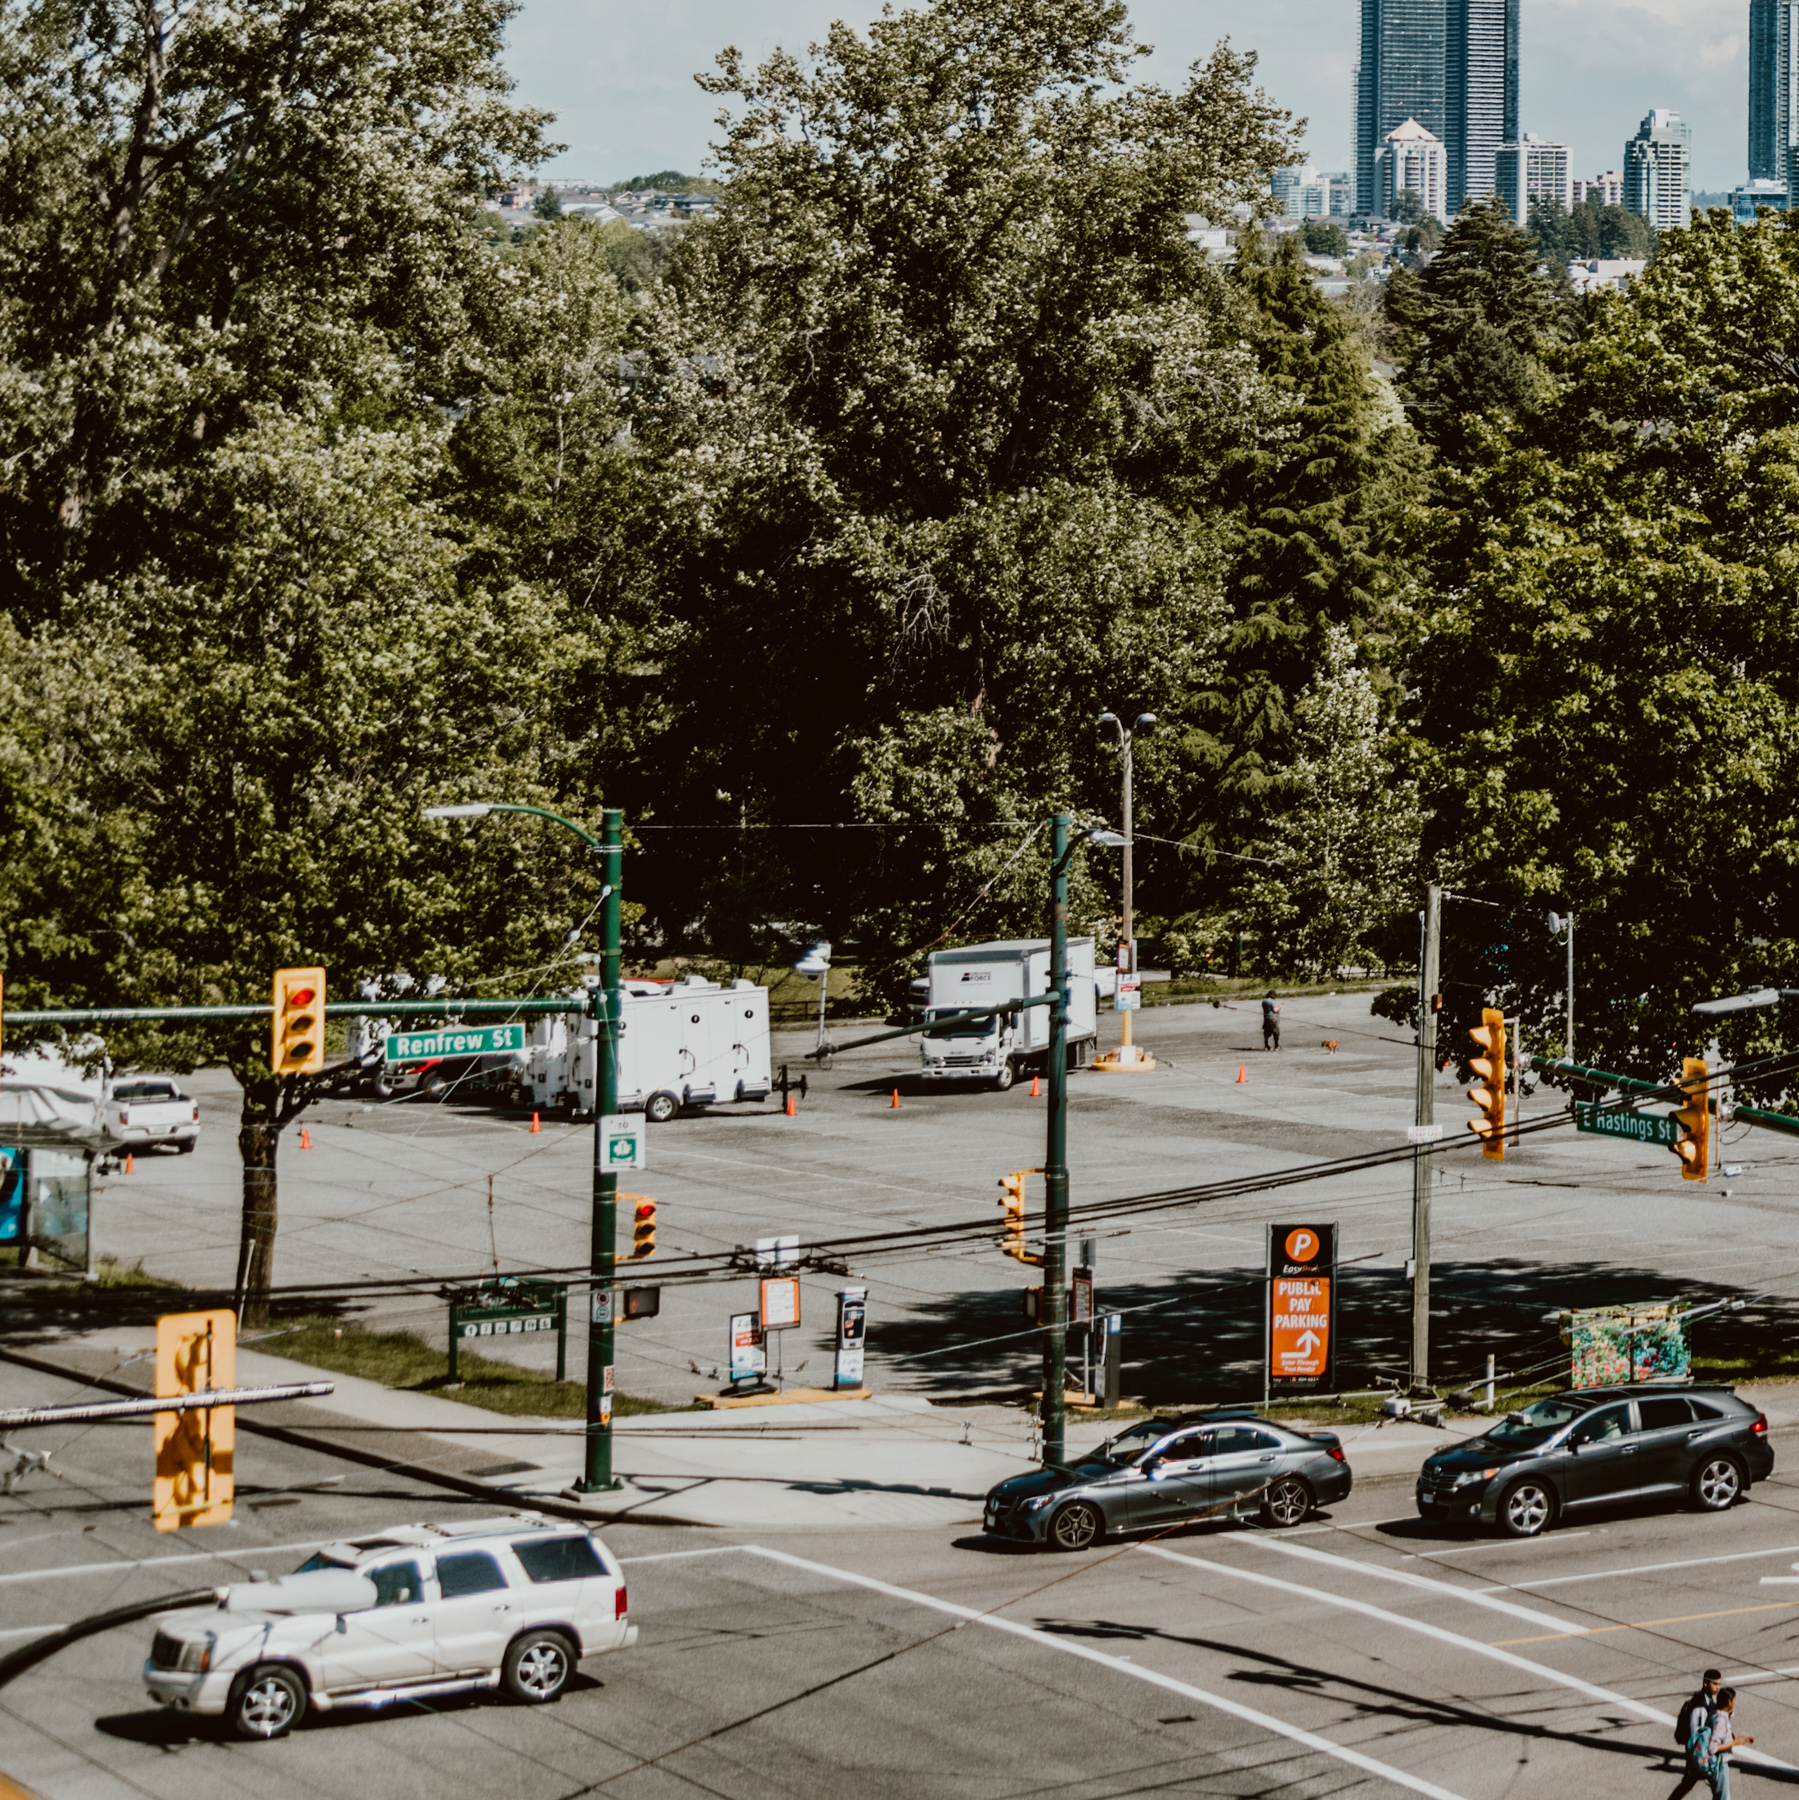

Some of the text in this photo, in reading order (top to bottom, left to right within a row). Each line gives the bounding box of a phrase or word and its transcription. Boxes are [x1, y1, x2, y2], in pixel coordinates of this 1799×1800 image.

[397, 1029, 513, 1056] Renfrew St
[1584, 1107, 1671, 1140] E Hastings St
[1294, 1233, 1311, 1256] P
[1280, 1281, 1322, 1296] PUBLIC
[1289, 1297, 1312, 1312] PAY
[1275, 1314, 1327, 1329] PARKING
